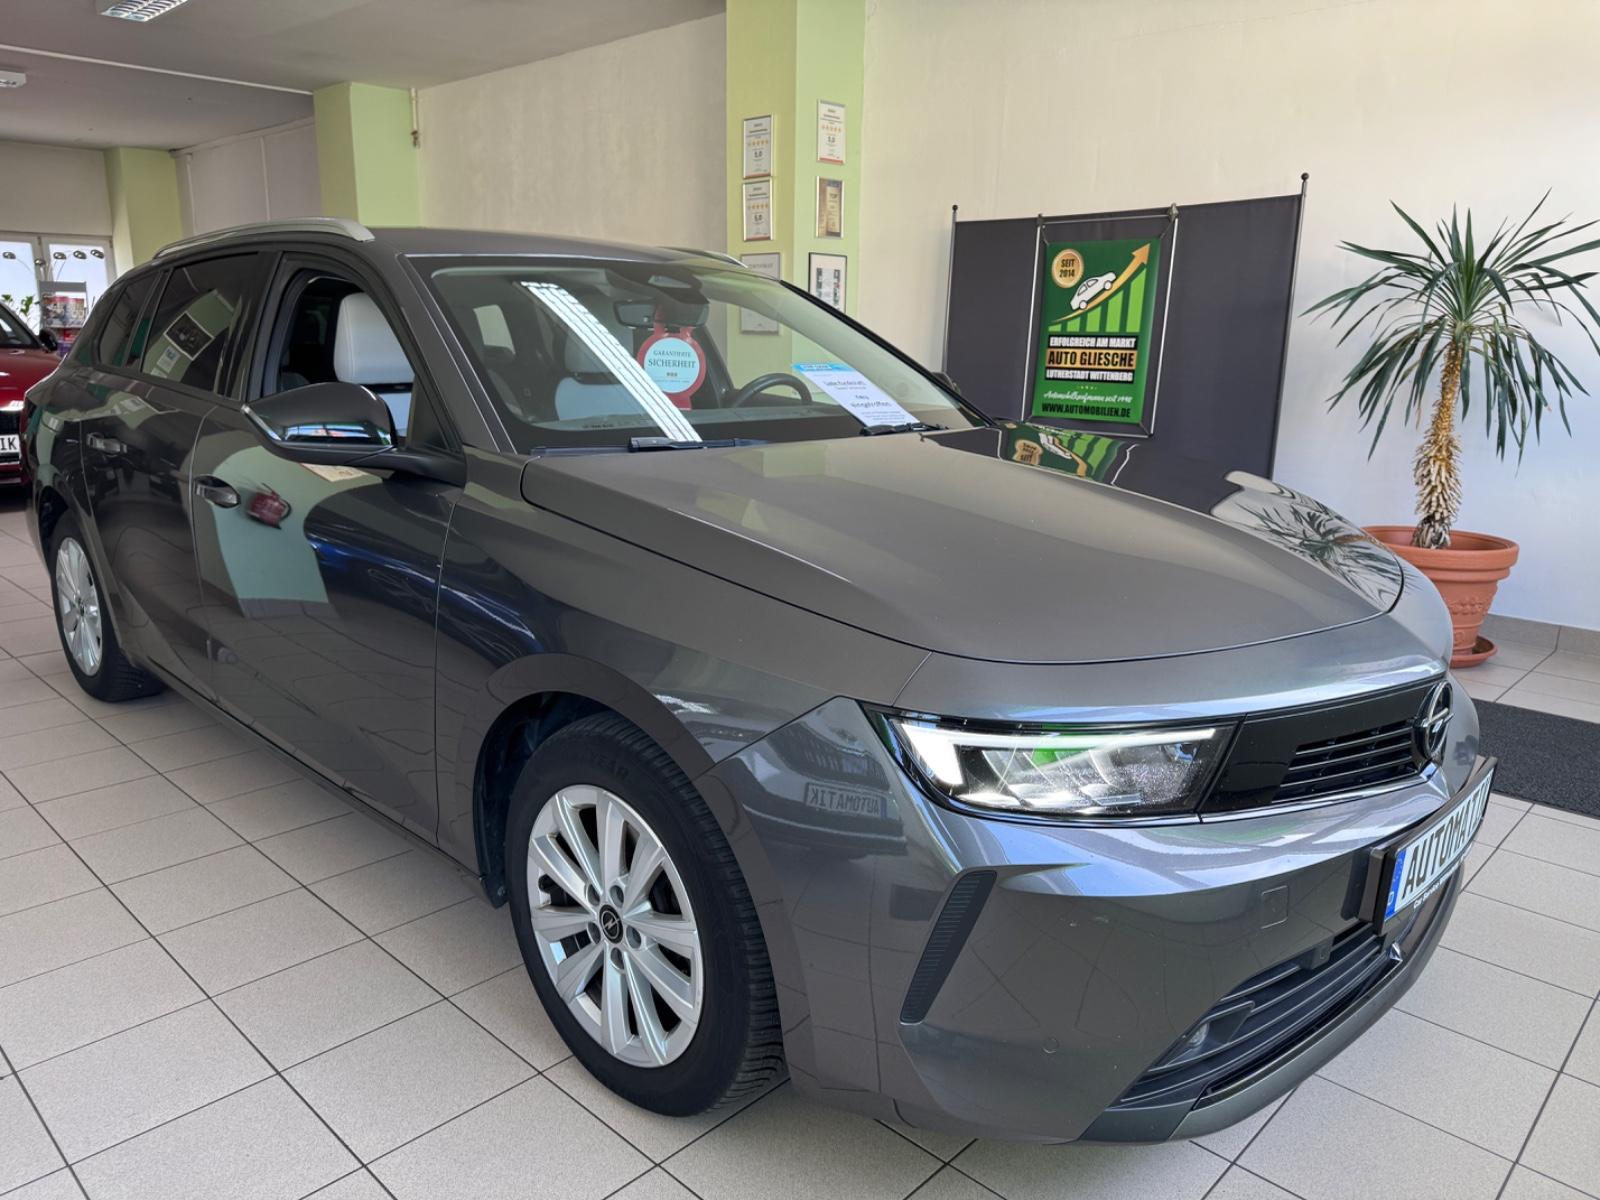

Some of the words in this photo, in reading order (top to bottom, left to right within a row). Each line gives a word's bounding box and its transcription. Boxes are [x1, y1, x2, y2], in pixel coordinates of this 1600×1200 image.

[1060, 258, 1075, 268] SEIT
[1059, 269, 1075, 277] 2014
[1049, 336, 1096, 347] ERFOLGREICH
[1096, 337, 1109, 347] AM
[1108, 337, 1136, 348] MARKT
[647, 359, 696, 368] SICHERHEIT
[1047, 350, 1077, 365] AUTO
[1080, 351, 1134, 367] GLIESCHE
[1046, 369, 1089, 380] LUTHERSTADT
[1089, 370, 1133, 382] WITTENBERG
[1042, 403, 1131, 418] WWW.AUTOMOBILIEN.DE
